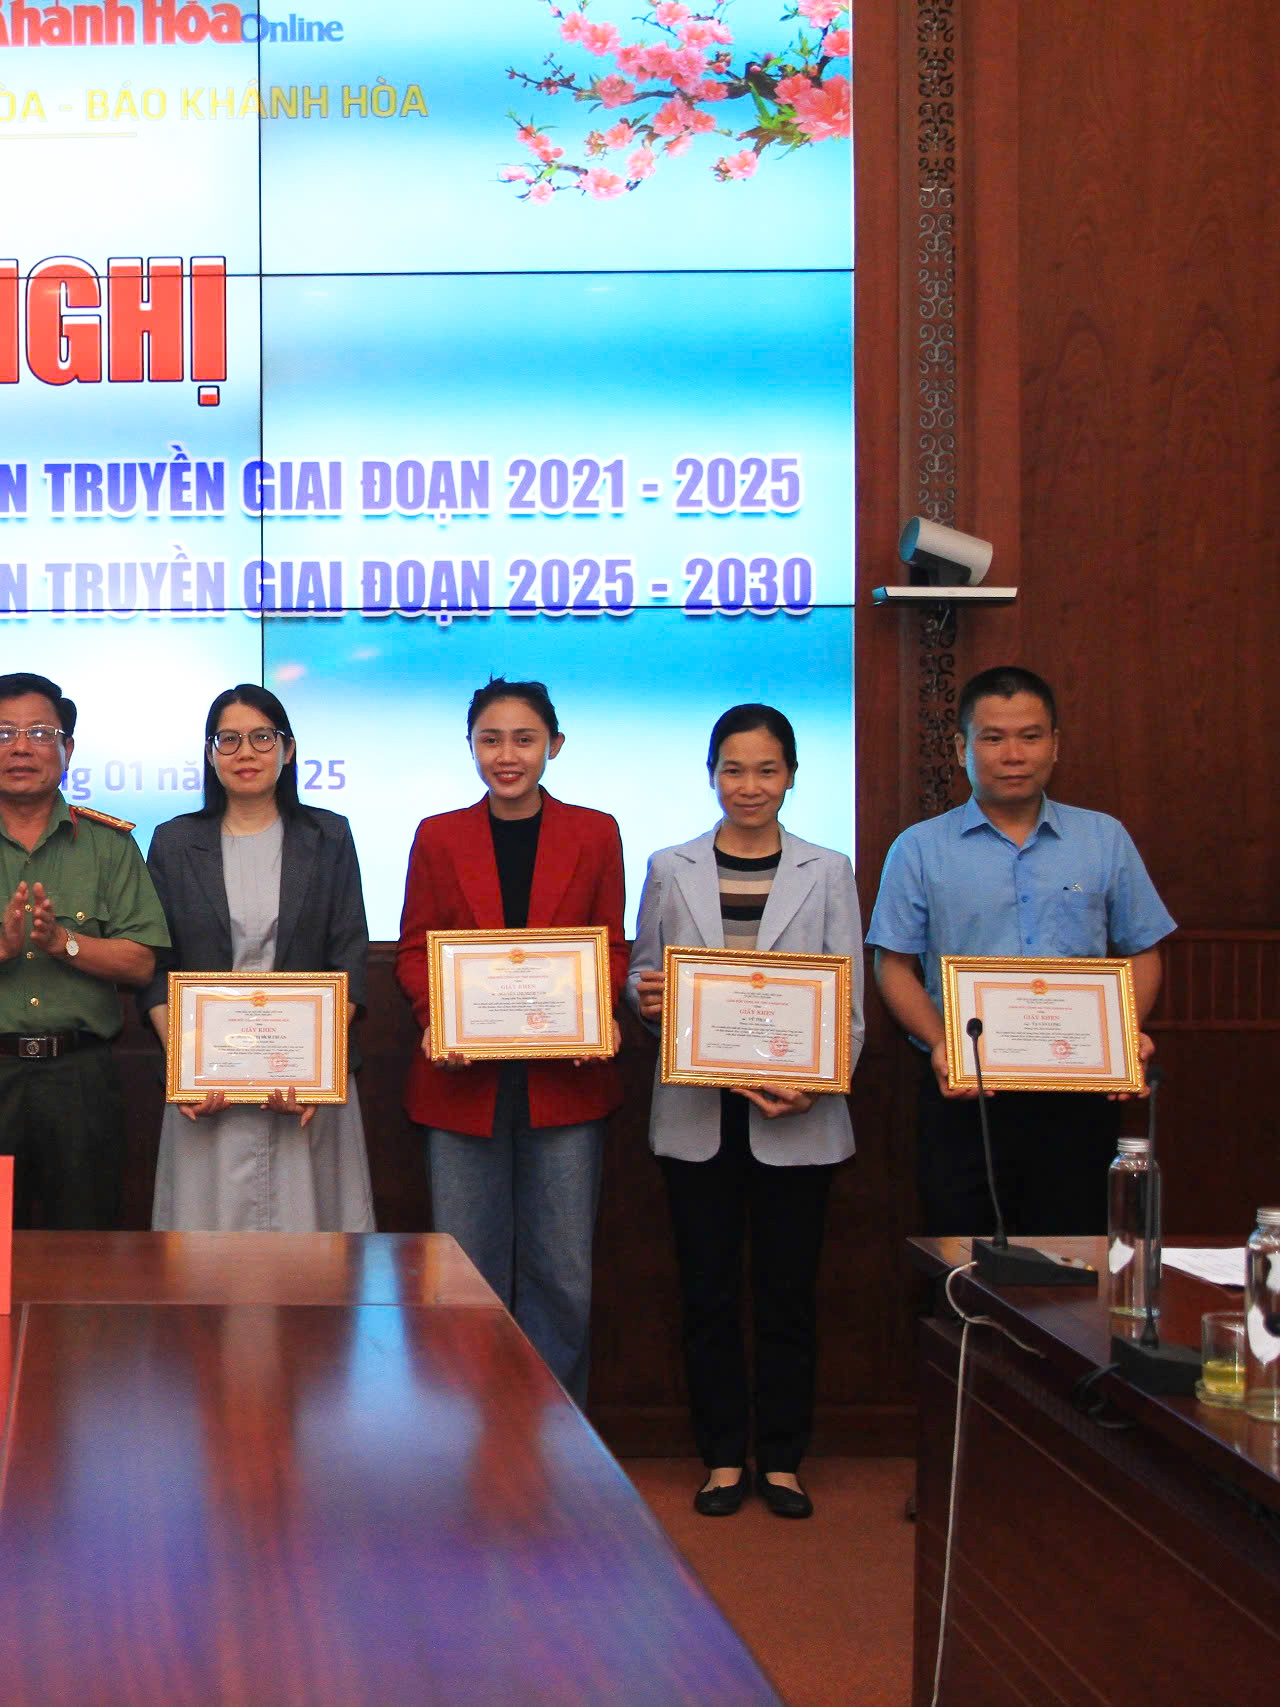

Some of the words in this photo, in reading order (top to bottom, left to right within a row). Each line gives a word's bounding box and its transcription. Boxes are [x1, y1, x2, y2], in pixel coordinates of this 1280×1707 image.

[86, 80, 167, 121] BÁO
[180, 77, 328, 120] KHÁNH
[341, 76, 429, 119] HÒA
[44, 444, 224, 513] TRUYỀN
[242, 460, 342, 511] GIAI
[360, 460, 490, 519] ĐOẠN
[508, 458, 624, 509] 2021
[675, 457, 801, 509] 2025
[44, 545, 224, 612] TRUYỀN
[242, 560, 343, 612] GIAI
[360, 560, 490, 622] ĐOẠN
[508, 558, 633, 611] 2025
[684, 557, 812, 611] 2030
[104, 760, 143, 792] 01
[157, 759, 205, 792] nă
